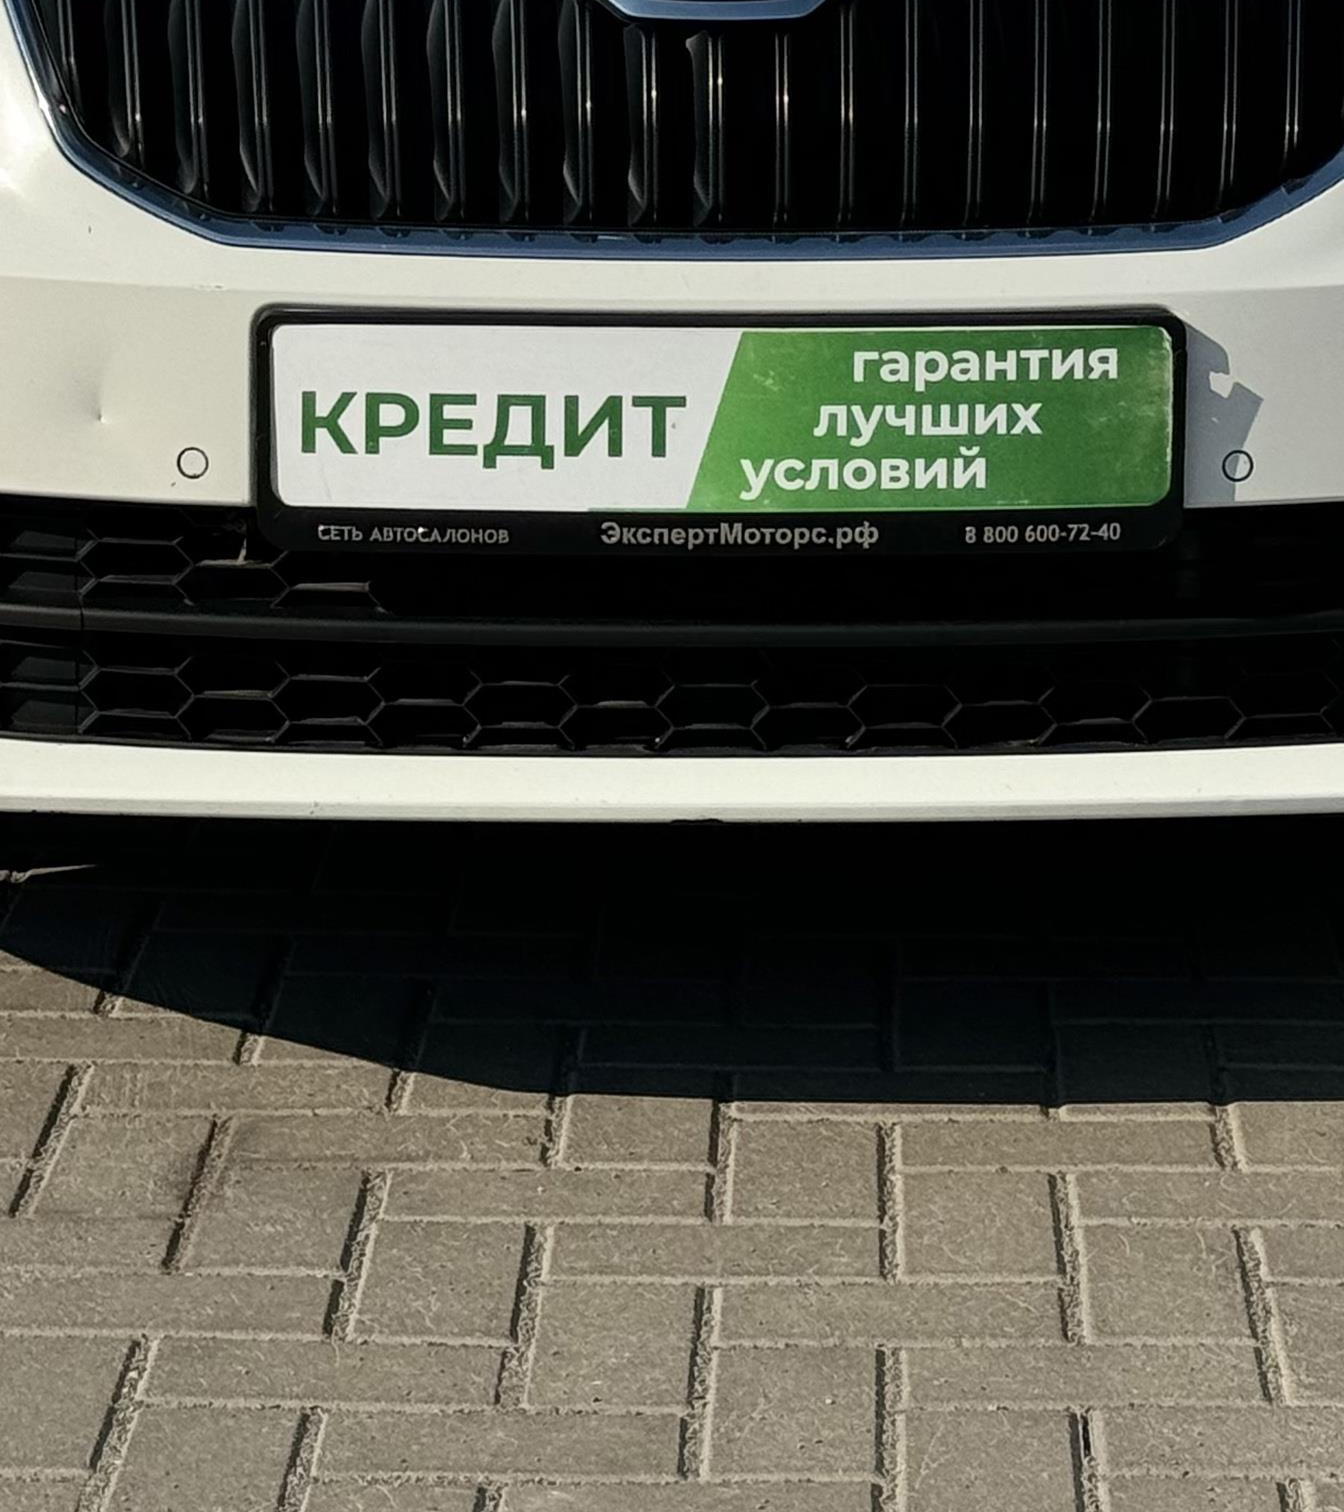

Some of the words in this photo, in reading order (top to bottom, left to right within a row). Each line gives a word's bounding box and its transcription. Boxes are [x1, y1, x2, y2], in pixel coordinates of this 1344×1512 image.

[852, 347, 1119, 392] гарантия
[300, 390, 687, 470] КРЕДИТ
[813, 402, 1044, 447] лучших
[739, 445, 988, 502] условий
[317, 524, 363, 542] СЕТЬ
[369, 526, 510, 545] АВТОСАЛОНОВ
[600, 521, 880, 550] ЭкспертМоторс.рф
[965, 527, 977, 544] 8
[983, 526, 1019, 543] 800
[1024, 522, 1121, 543] 600-72-40
